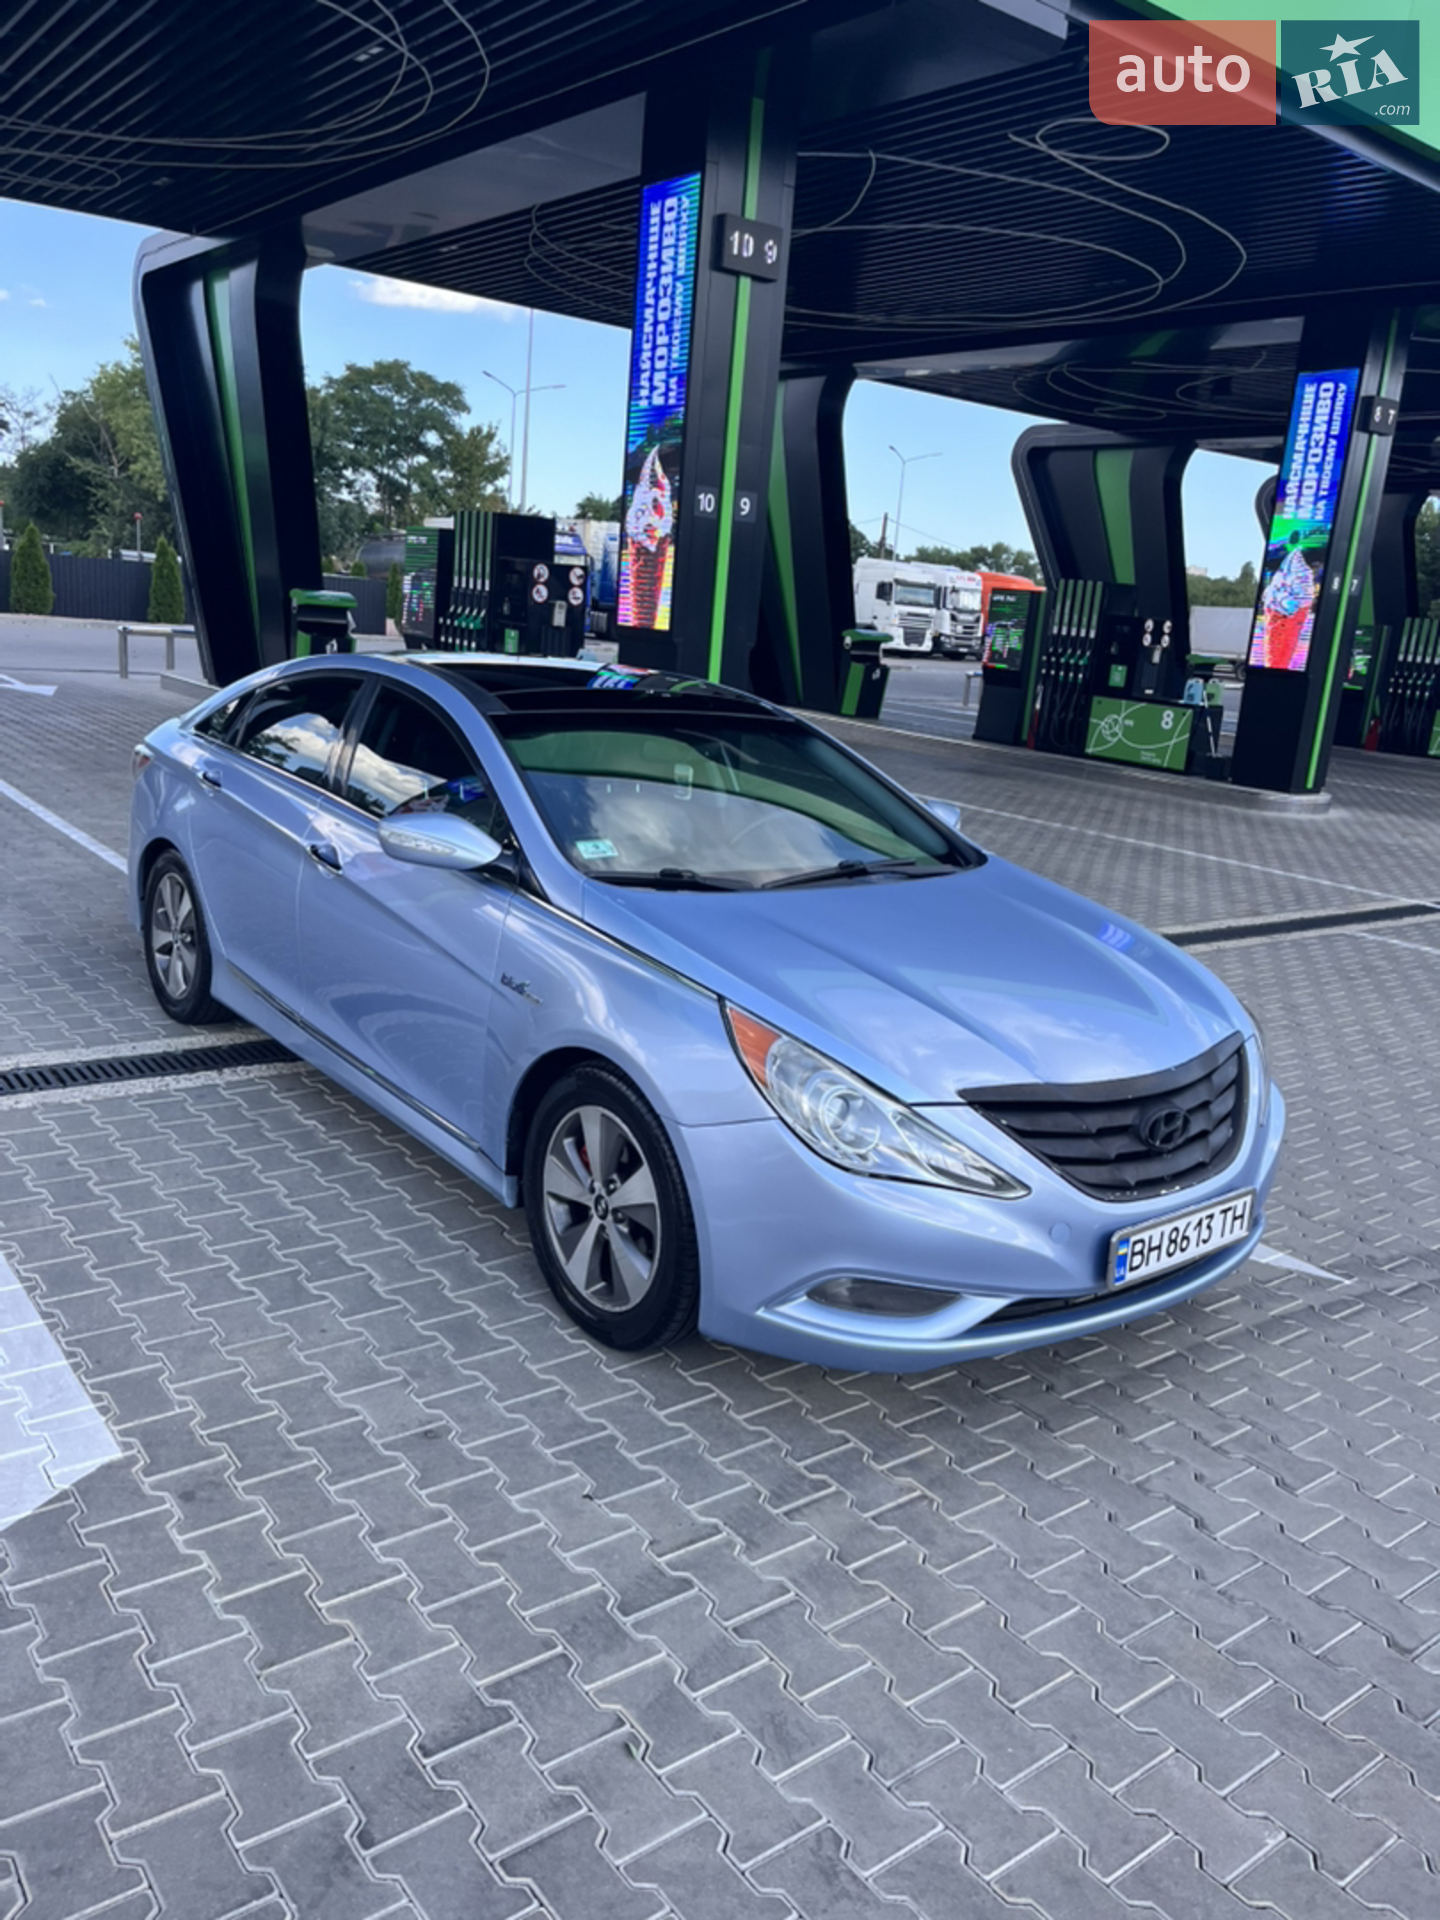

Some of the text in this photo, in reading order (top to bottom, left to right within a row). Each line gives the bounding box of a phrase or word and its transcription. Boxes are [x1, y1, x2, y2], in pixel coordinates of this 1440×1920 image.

[730, 230, 778, 265] 10 9
[638, 199, 662, 408] НАЙСМАЧНІШЕ
[651, 196, 679, 406] МОРОЗИВО
[667, 376, 678, 405] НА
[1282, 382, 1317, 520] НАЙСМАЧНІШЕ
[1298, 381, 1335, 520] МОРОЗИВО
[697, 493, 751, 516] 10 9
[1161, 710, 1174, 730] 8
[1128, 1200, 1248, 1273] BH 8613 TH
